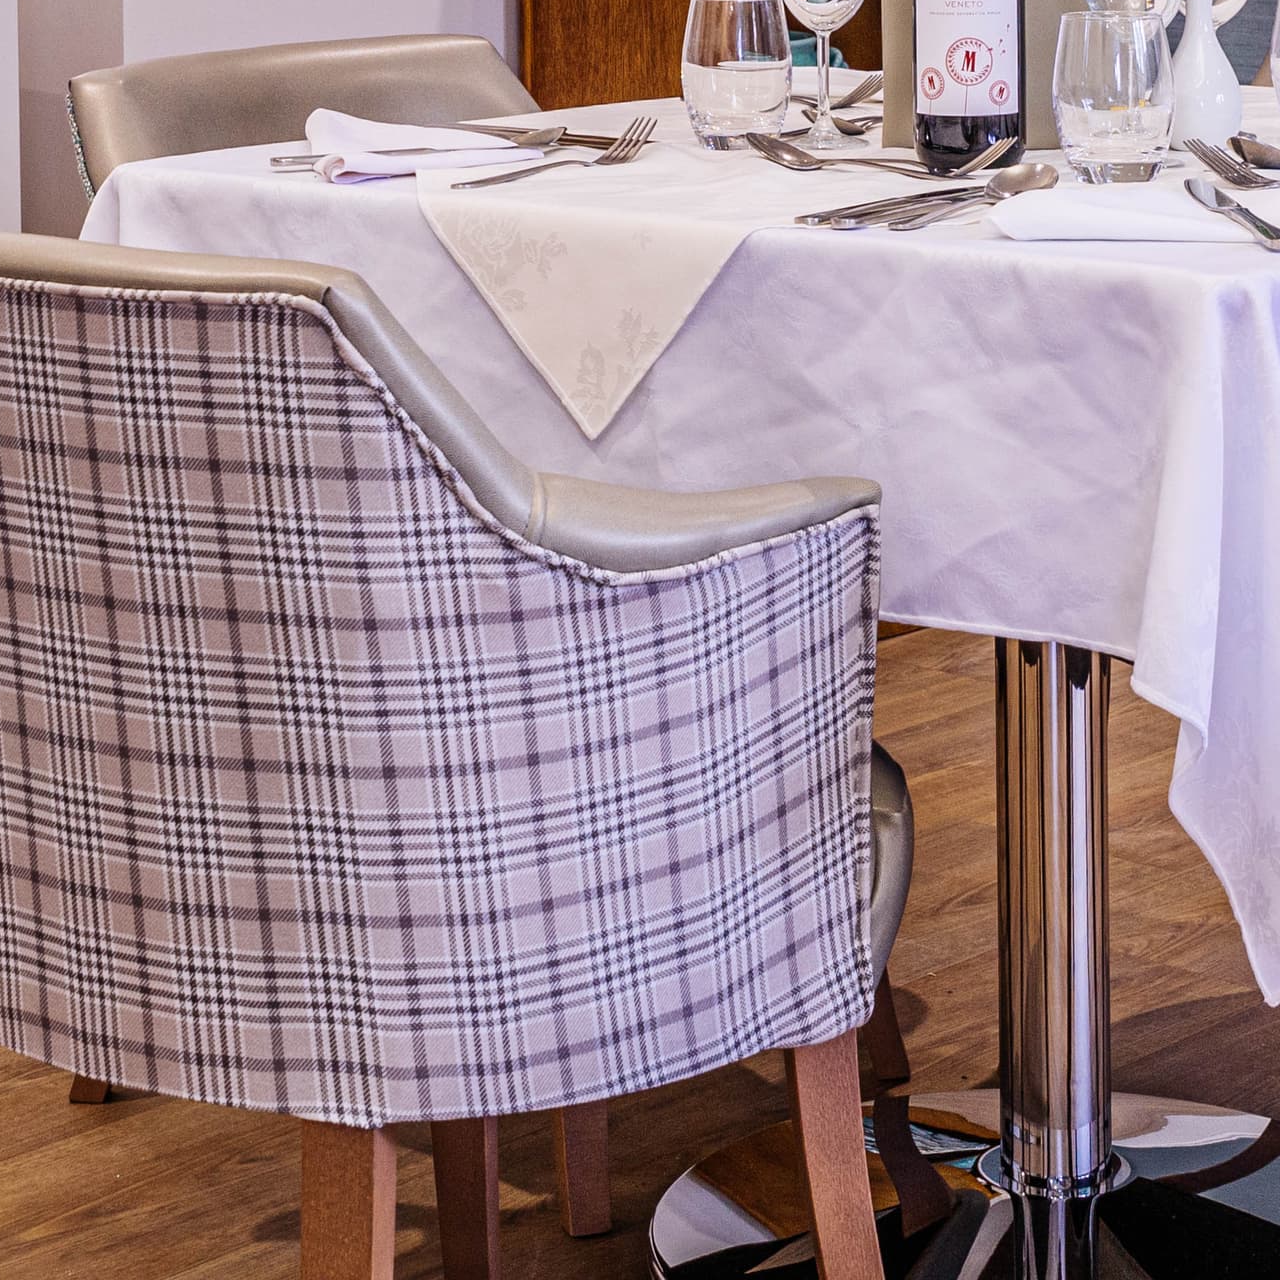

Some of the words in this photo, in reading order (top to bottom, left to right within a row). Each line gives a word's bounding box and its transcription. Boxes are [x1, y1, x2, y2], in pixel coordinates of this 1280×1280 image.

[944, 0, 984, 9] VENETO
[961, 50, 977, 73] M
[927, 75, 936, 90] M
[995, 86, 1005, 100] M
